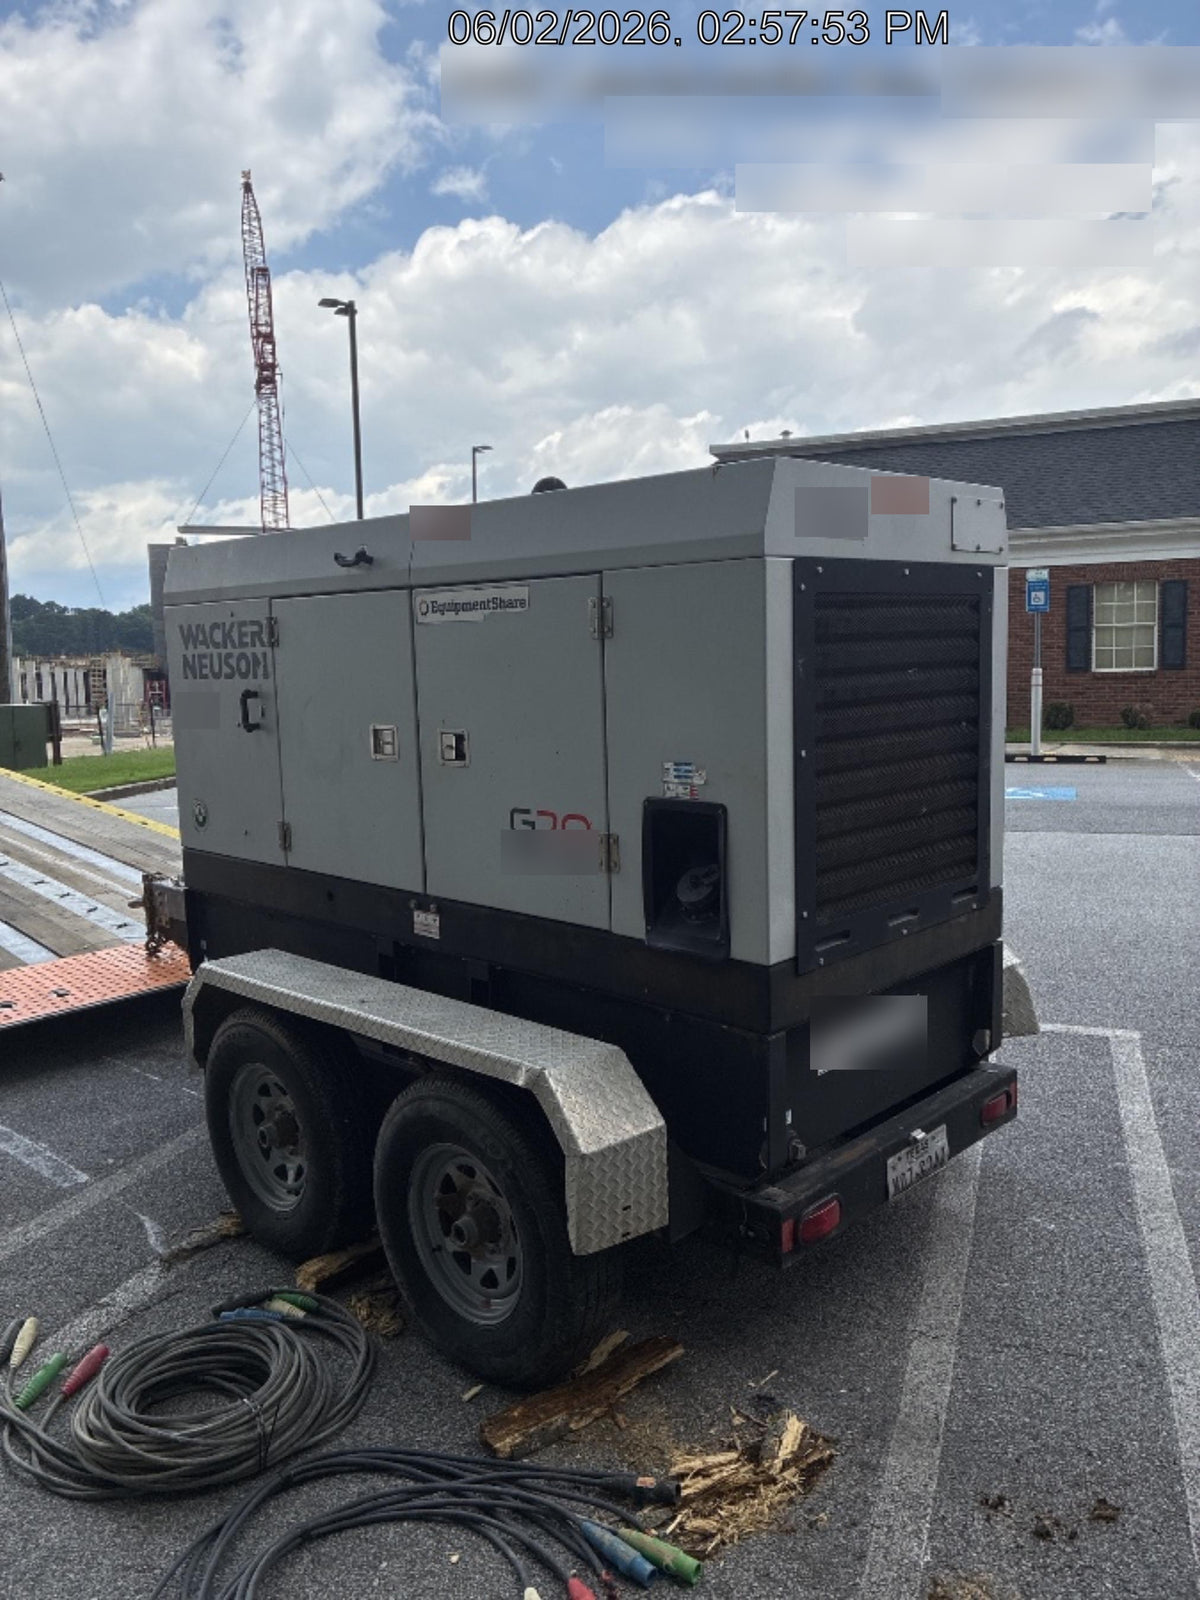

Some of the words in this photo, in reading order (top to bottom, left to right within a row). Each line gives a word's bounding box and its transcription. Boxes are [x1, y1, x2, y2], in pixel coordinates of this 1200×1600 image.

[431, 597, 527, 616] EquipmentShare
[178, 619, 266, 650] WACKER
[182, 651, 270, 680] NEUSON
